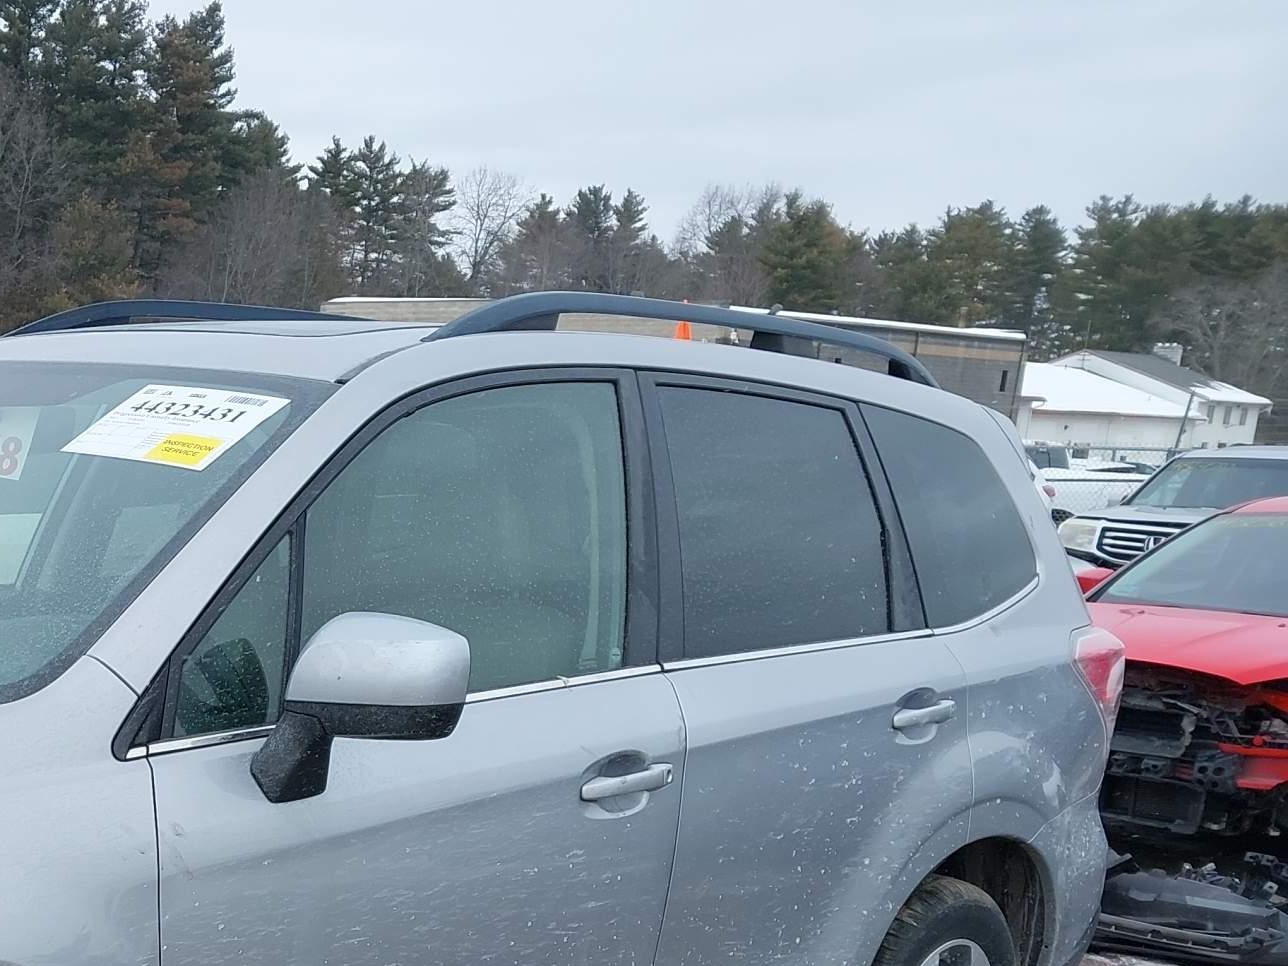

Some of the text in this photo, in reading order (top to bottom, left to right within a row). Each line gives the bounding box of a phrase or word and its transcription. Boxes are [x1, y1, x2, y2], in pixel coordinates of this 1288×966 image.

[130, 400, 247, 423] 44323431
[161, 446, 200, 457] SERVICE
[162, 438, 215, 452] INSPECTION
